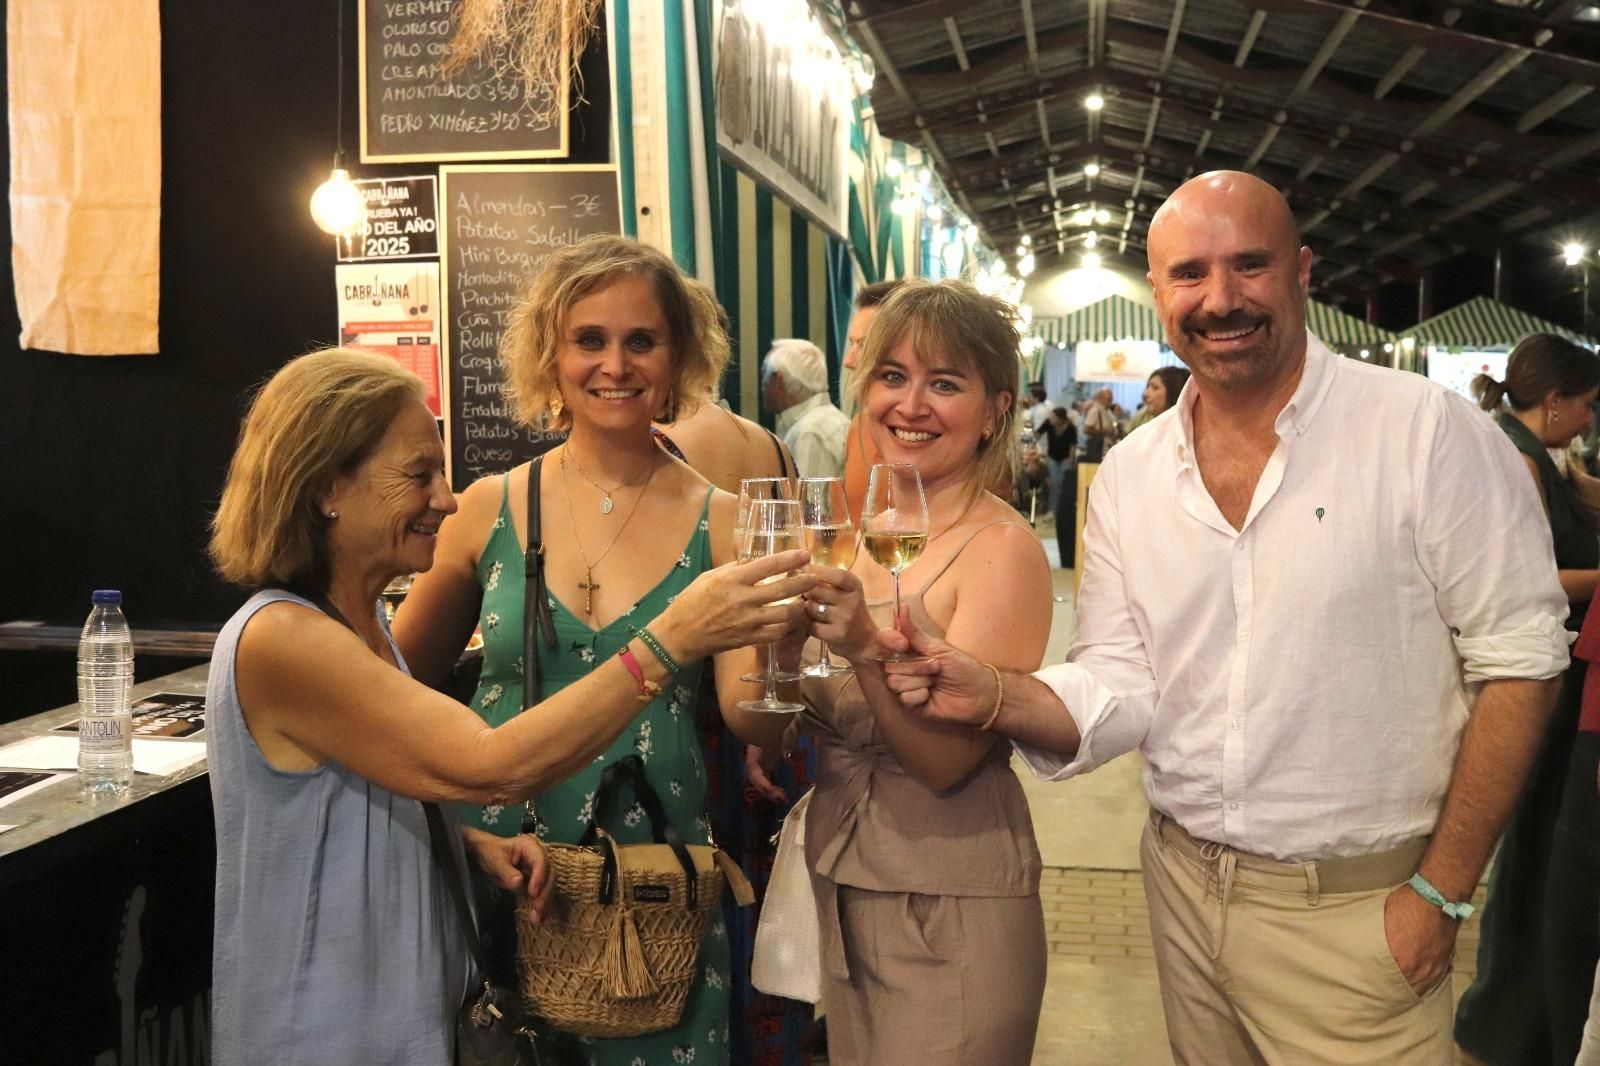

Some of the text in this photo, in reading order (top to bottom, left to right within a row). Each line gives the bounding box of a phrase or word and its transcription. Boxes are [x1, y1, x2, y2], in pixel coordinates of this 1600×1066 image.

[383, 20, 450, 38] OLOROSO
[384, 41, 421, 57] PALO
[382, 64, 446, 80] CREAM
[383, 83, 481, 102] AMONTILLADO
[381, 113, 422, 133] PEDRO
[457, 191, 546, 216] Almendras
[374, 221, 402, 235] DEL
[404, 216, 435, 233] AÑO
[456, 215, 518, 240] Patatas
[366, 236, 410, 256] 2025
[459, 246, 490, 268] Mini
[458, 310, 490, 330] Cuña
[464, 444, 512, 464] Queso
